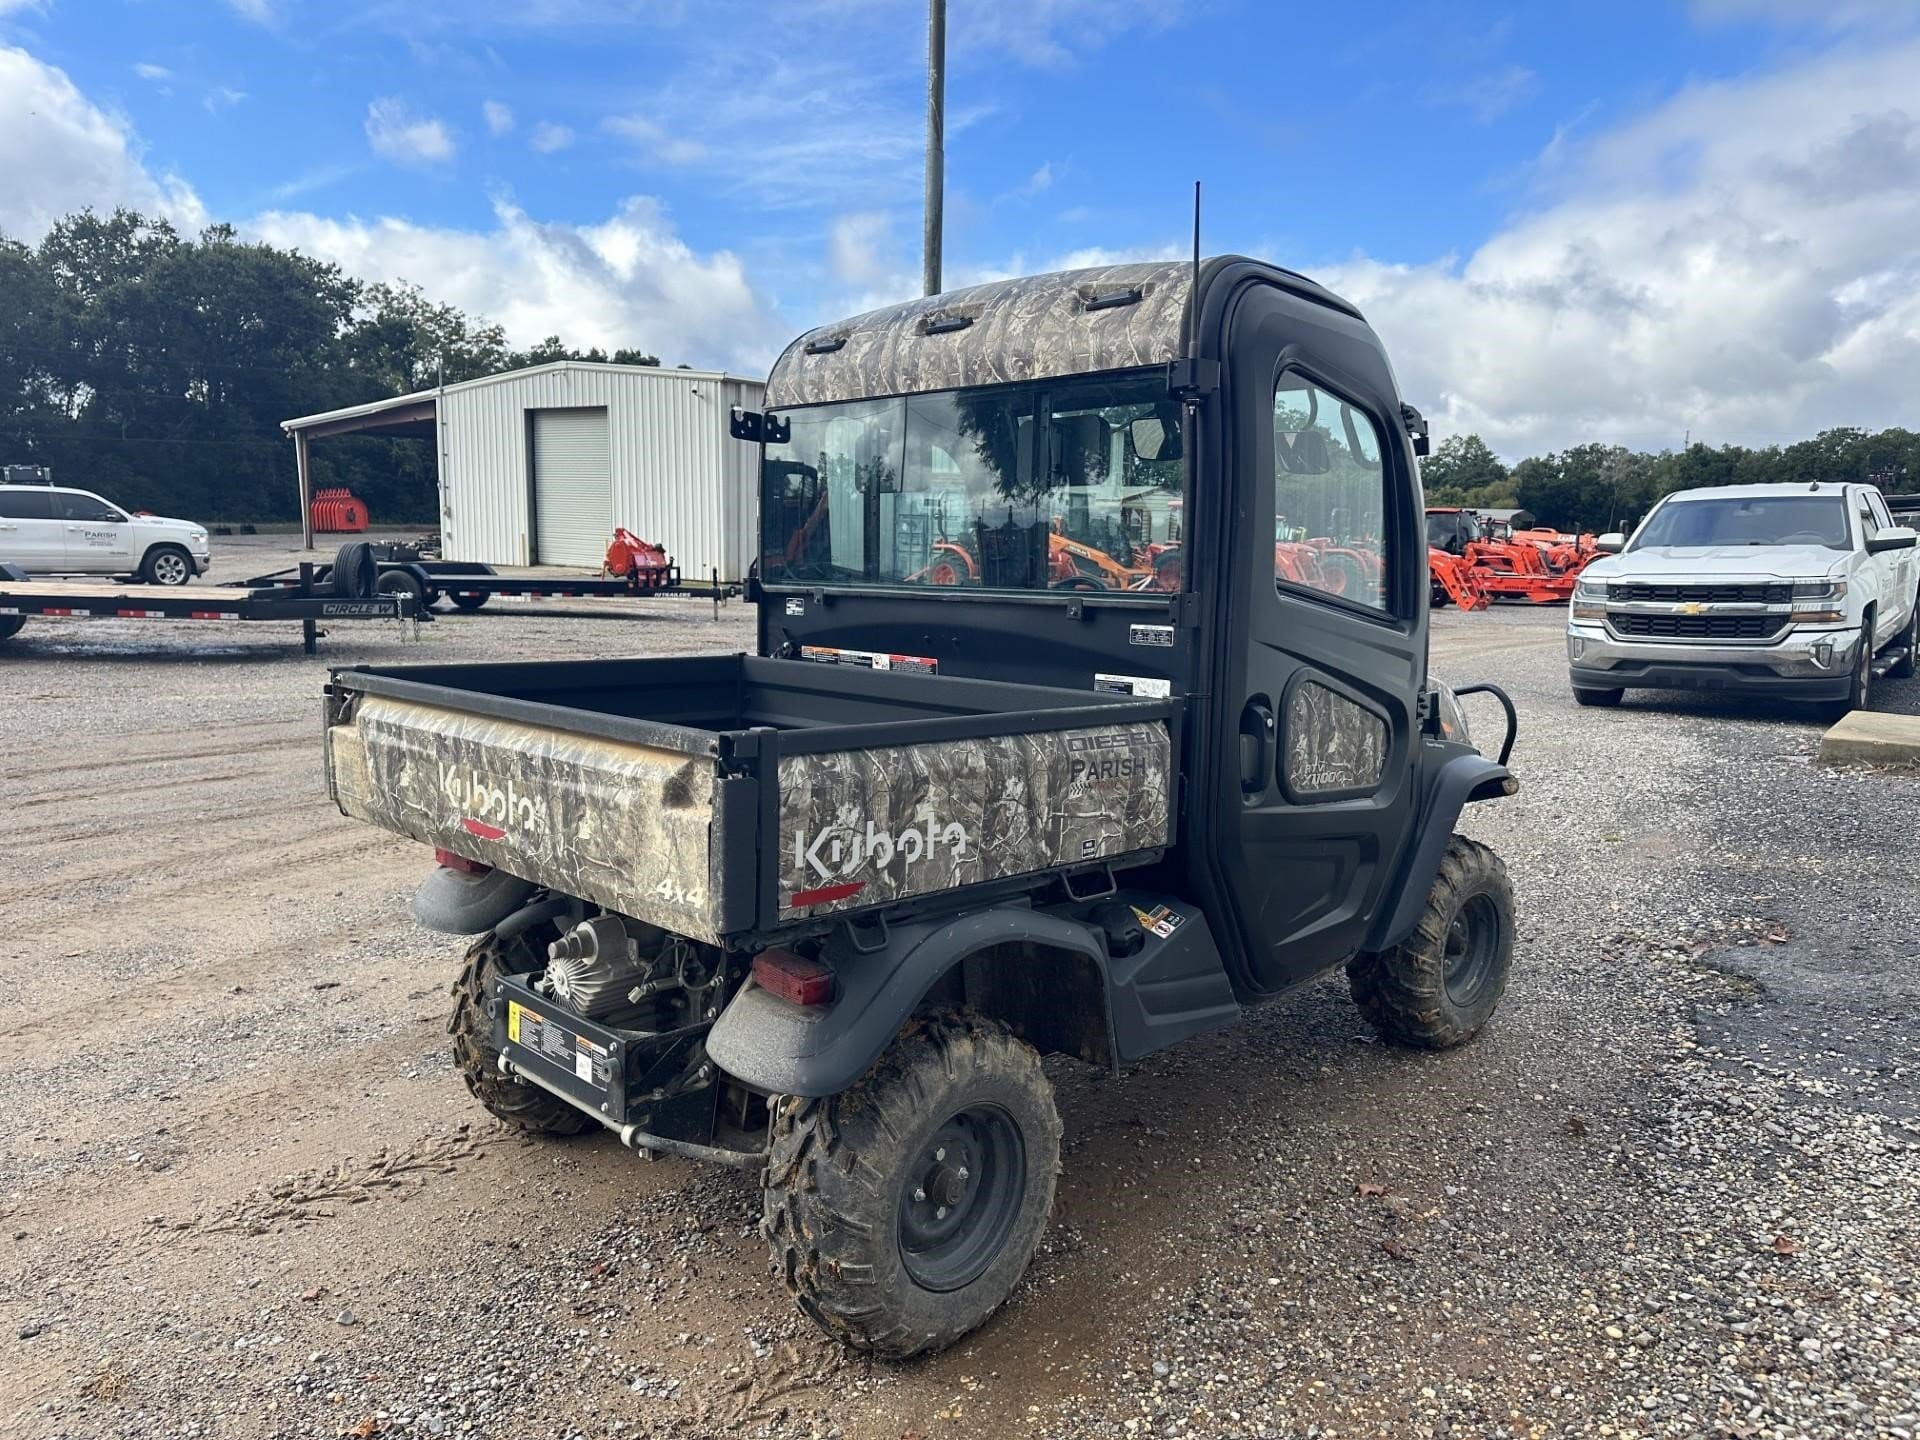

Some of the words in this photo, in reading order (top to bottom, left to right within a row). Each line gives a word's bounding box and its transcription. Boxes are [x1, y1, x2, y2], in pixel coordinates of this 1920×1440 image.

[84, 530, 117, 539] PARISH
[325, 604, 375, 614] CIRCLE
[378, 603, 393, 613] W
[1066, 731, 1165, 752] DIESEL
[1070, 757, 1146, 783] PARISH
[439, 762, 535, 832] Kubota
[794, 811, 968, 880] Kubota
[656, 878, 705, 909] 4x4
